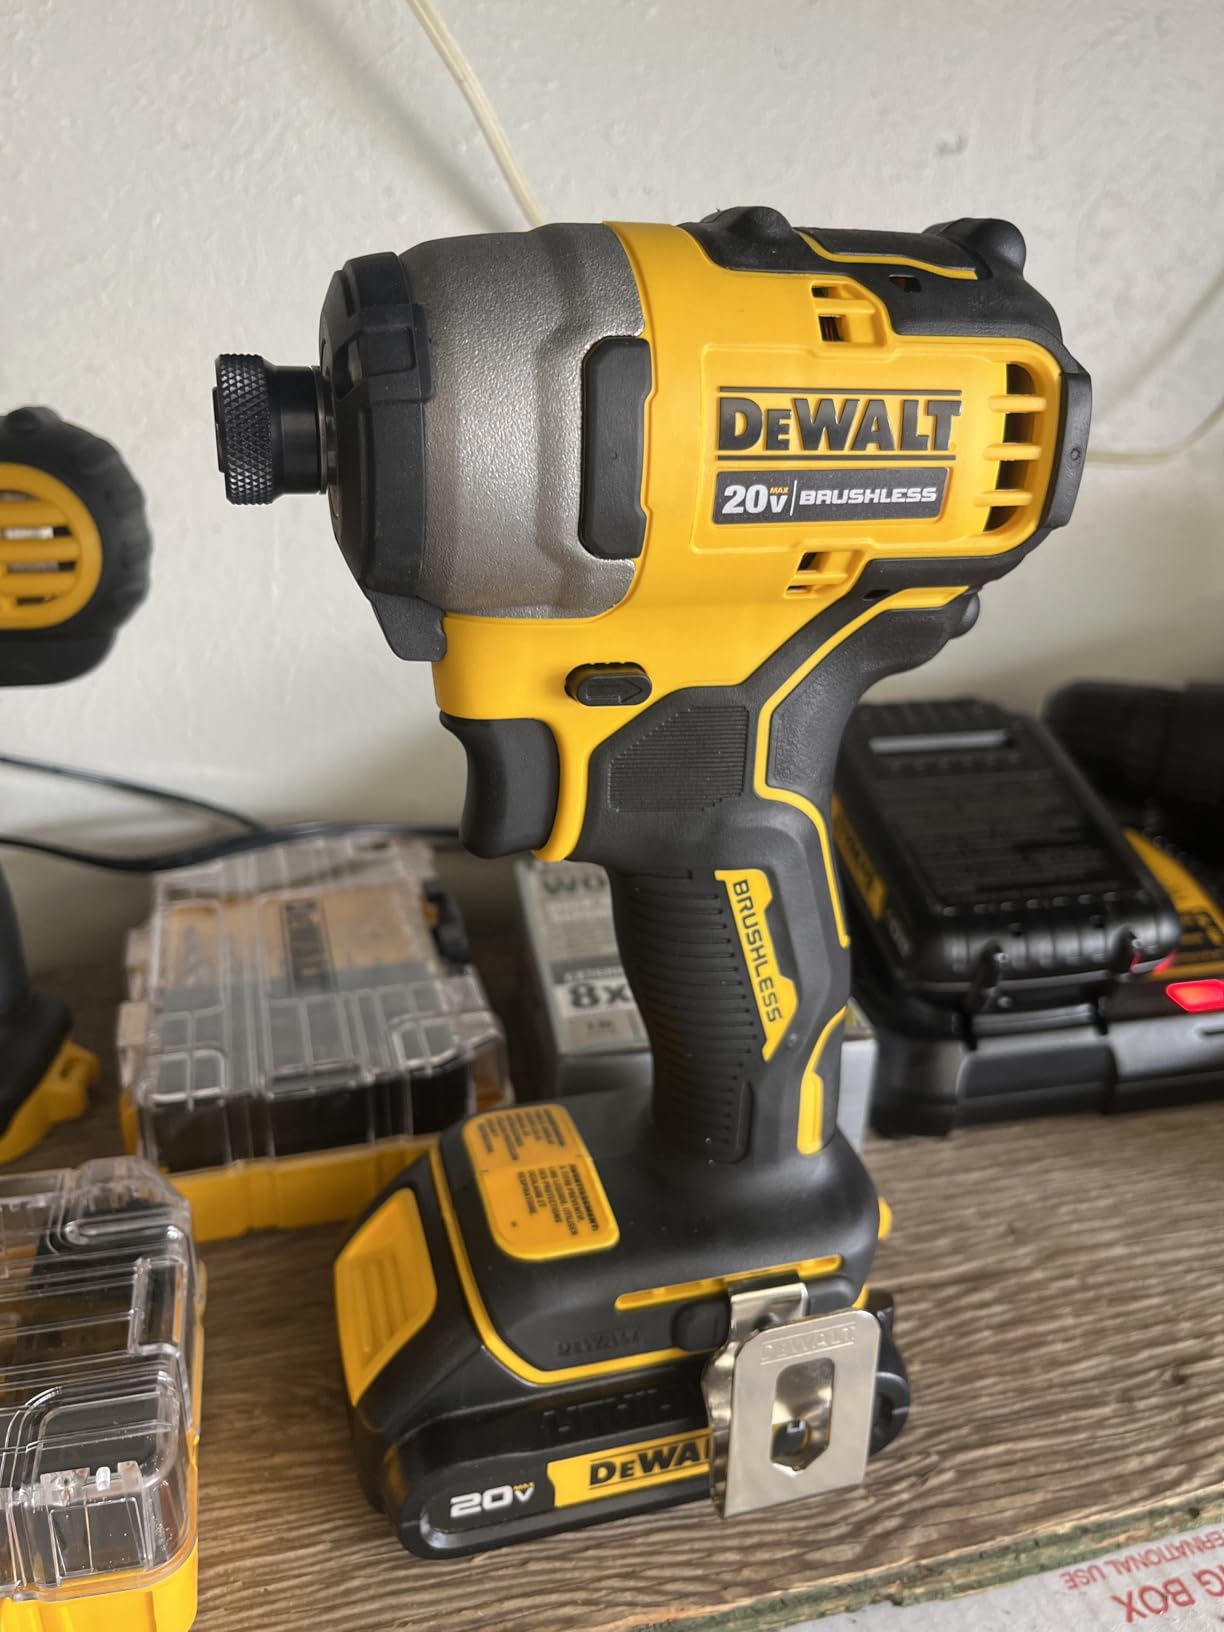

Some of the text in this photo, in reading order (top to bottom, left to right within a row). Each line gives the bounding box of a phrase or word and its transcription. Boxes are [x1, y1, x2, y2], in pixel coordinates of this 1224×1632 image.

[718, 396, 962, 451] DEWALT
[770, 486, 791, 495] MAX
[799, 486, 937, 505] BRUSHLESS
[733, 879, 783, 1023] BRUSHLESS
[1060, 1565, 1106, 1590] USE
[1109, 1578, 1196, 1624] BOX
